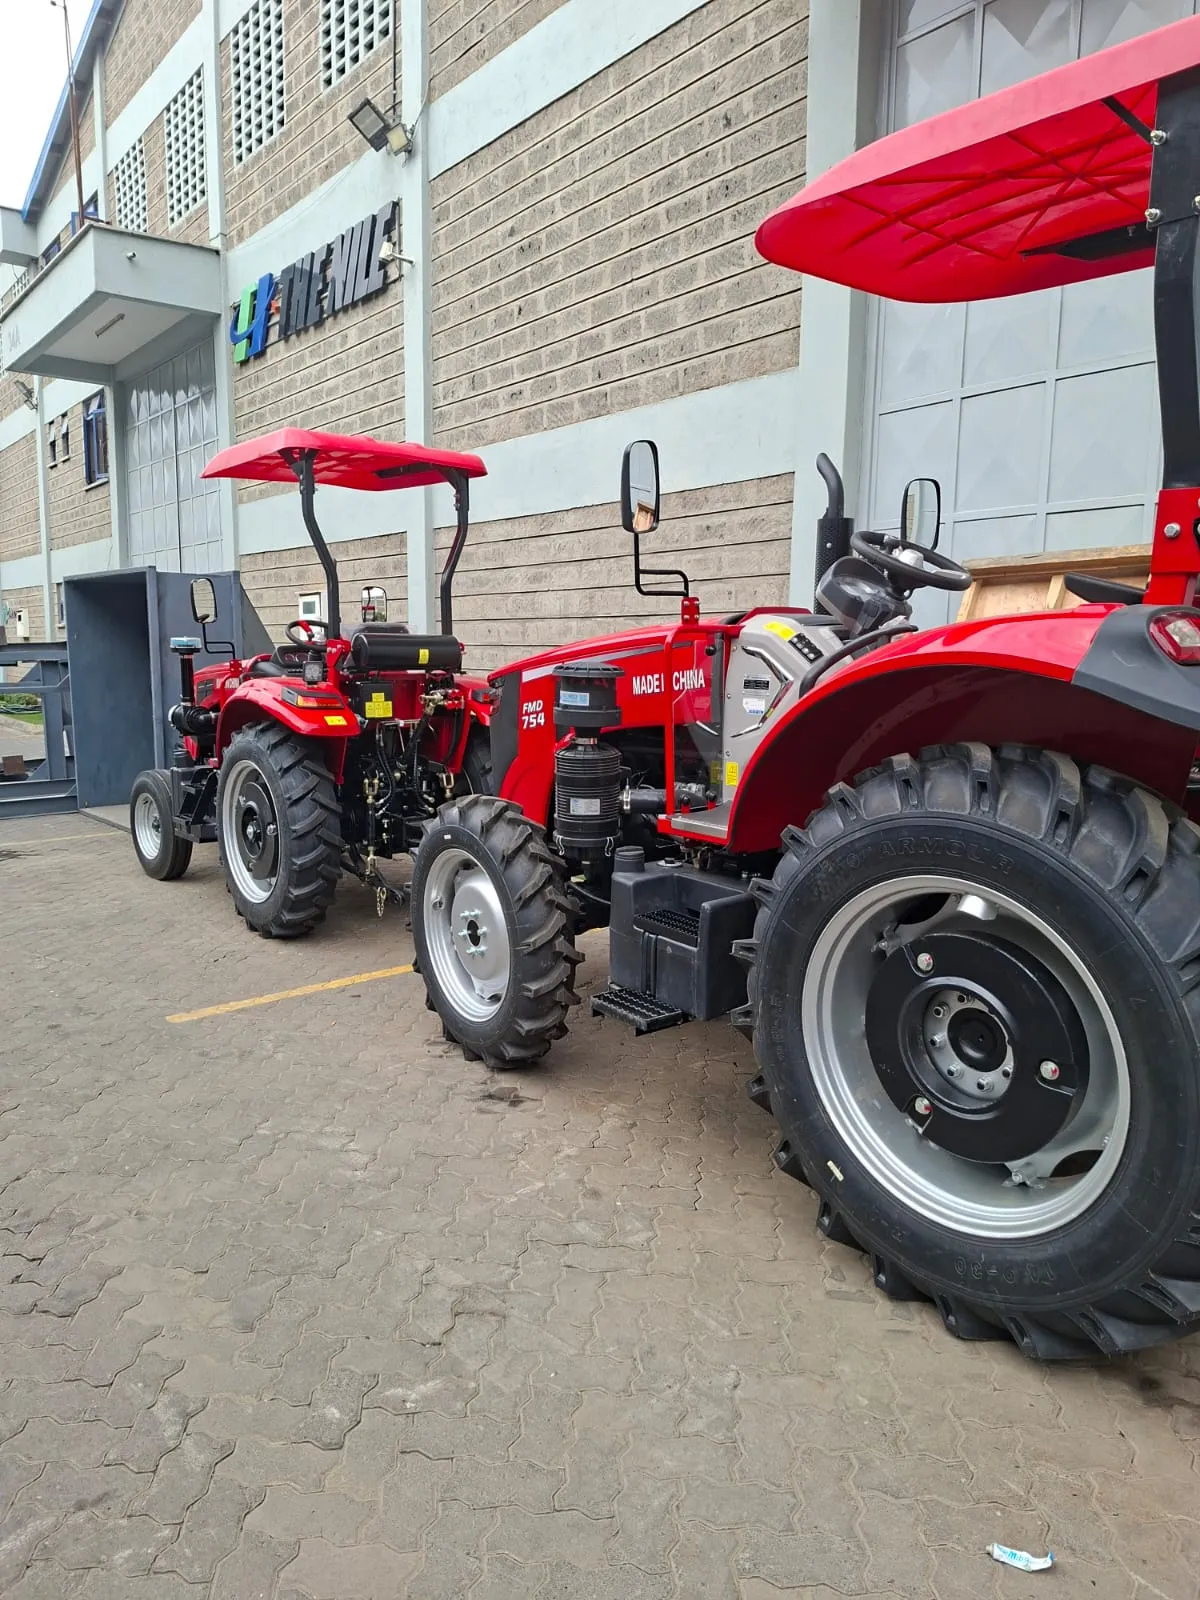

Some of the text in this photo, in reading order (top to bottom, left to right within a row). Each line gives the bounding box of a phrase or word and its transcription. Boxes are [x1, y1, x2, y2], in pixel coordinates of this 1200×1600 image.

[278, 200, 397, 338] THE NILE
[632, 675, 660, 695] MADE
[672, 669, 705, 691] CHINA
[522, 699, 544, 715] FMD
[521, 712, 545, 729] 754
